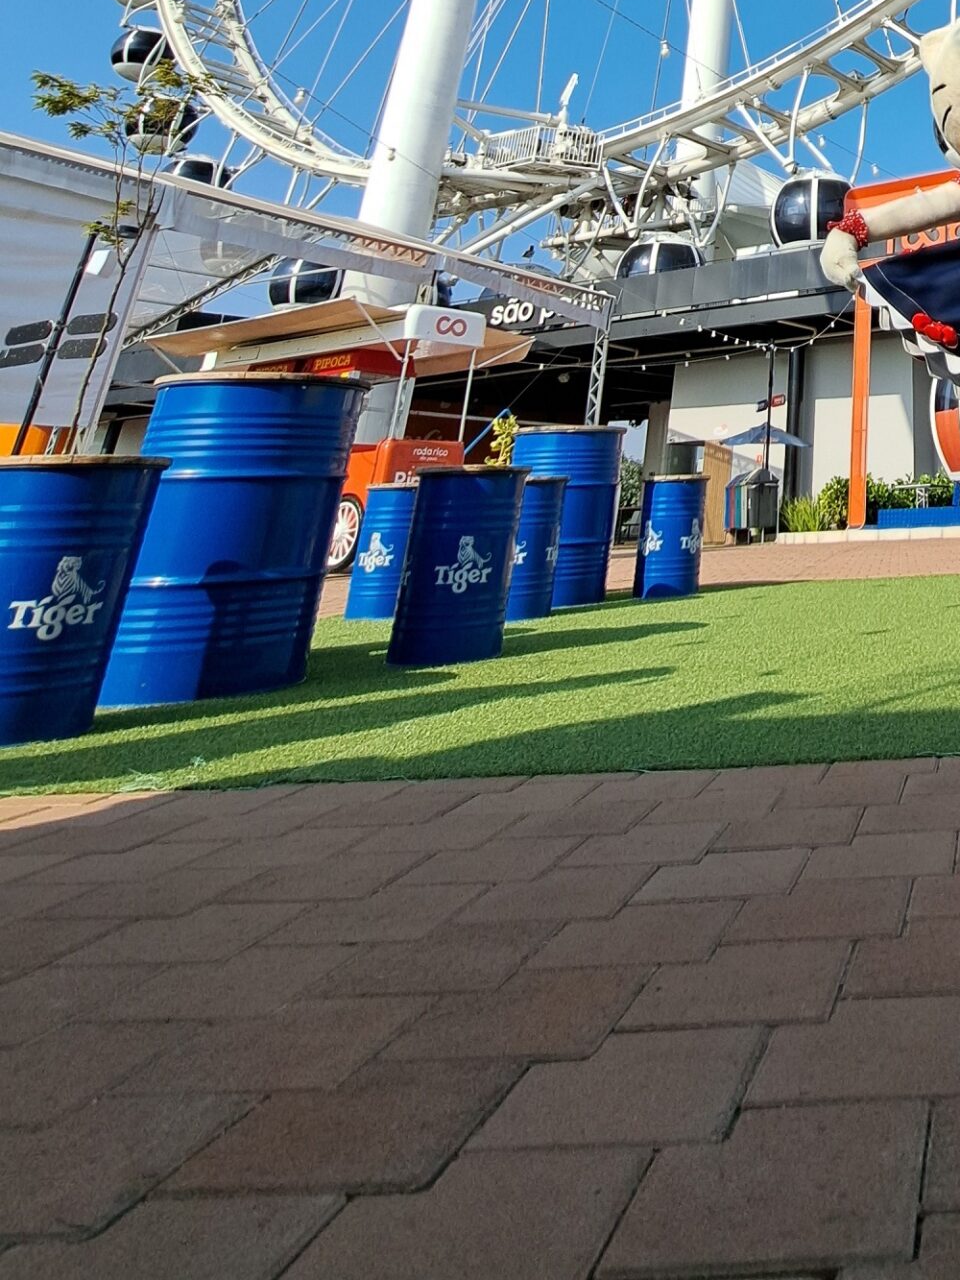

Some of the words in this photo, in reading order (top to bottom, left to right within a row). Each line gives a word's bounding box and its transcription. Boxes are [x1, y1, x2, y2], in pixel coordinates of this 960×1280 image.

[489, 297, 534, 325] são
[314, 354, 352, 370] PIPOCA
[413, 447, 432, 456] roda
[432, 447, 449, 457] rico
[358, 550, 394, 573] Tiger
[434, 562, 493, 594] Tiger
[7, 594, 104, 641] Tiger
